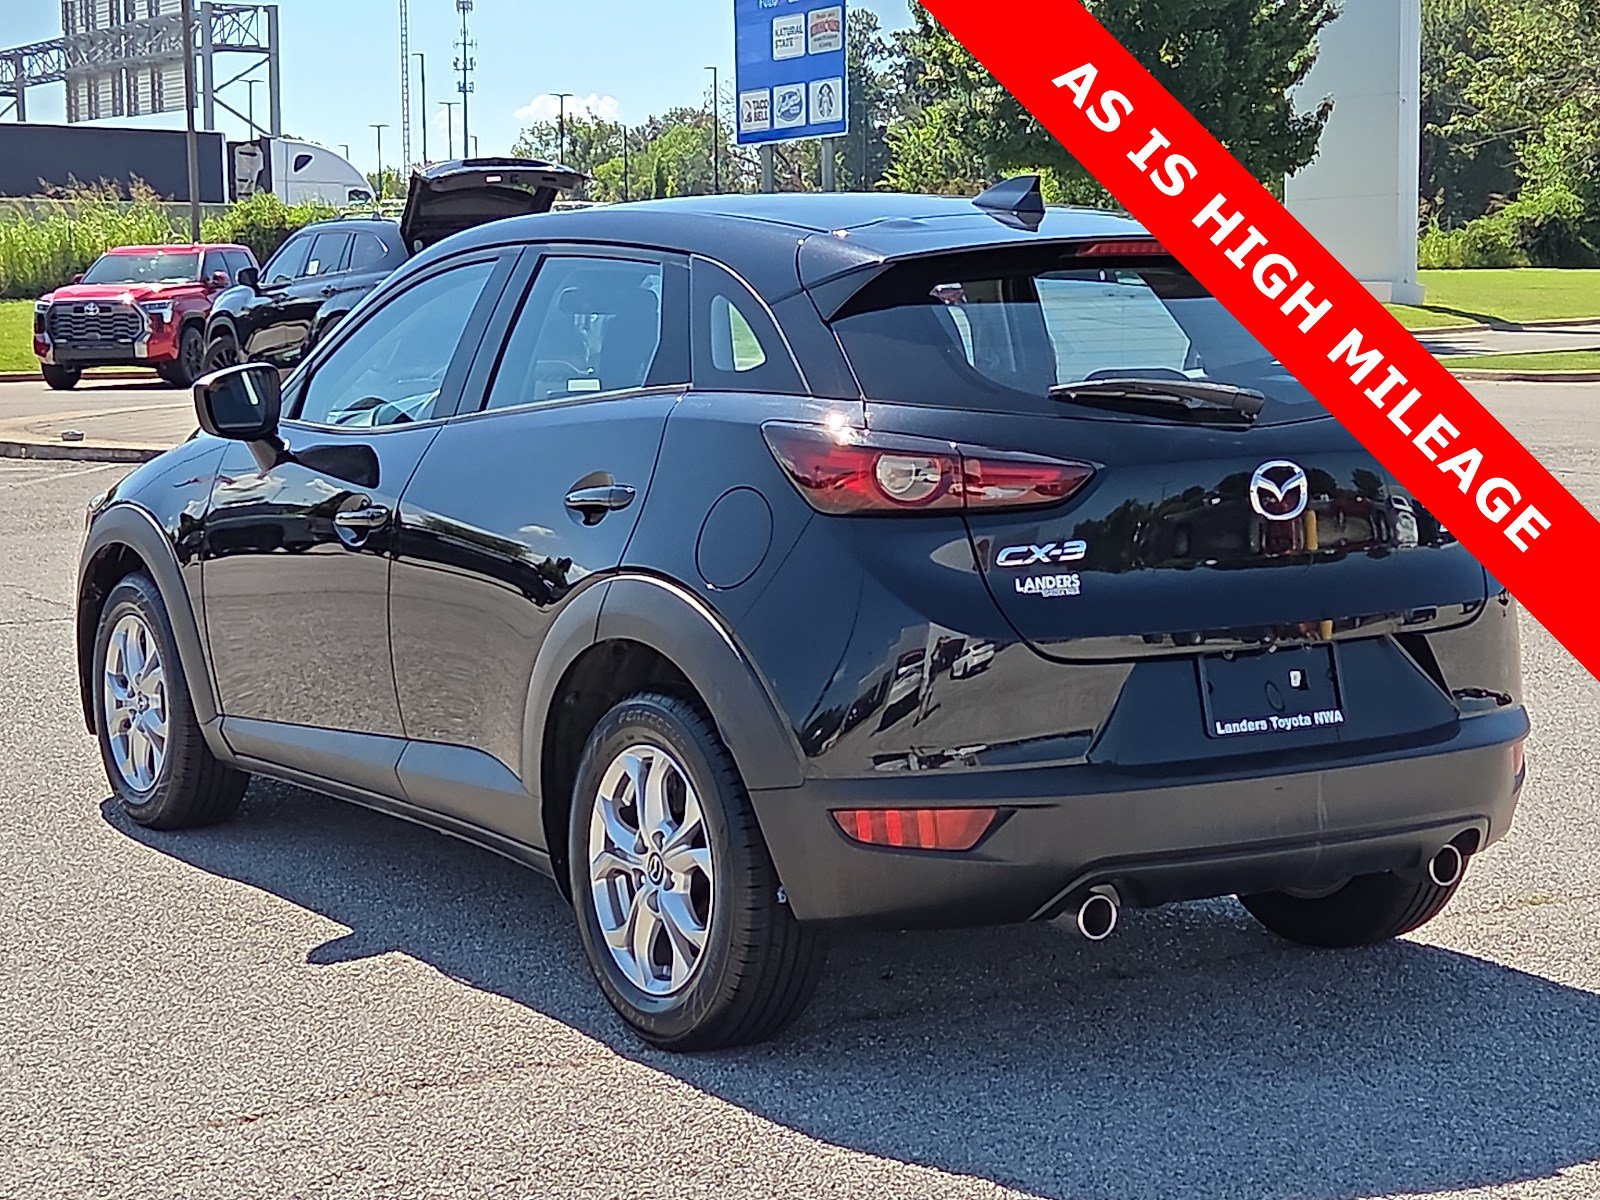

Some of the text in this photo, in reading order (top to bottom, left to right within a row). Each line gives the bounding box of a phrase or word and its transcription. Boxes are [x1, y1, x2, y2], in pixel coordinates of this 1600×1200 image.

[752, 99, 768, 109] TACO
[753, 111, 768, 121] BELL
[996, 540, 1087, 566] CX-3
[1015, 573, 1080, 593] LANDERS
[1215, 710, 1344, 735] Landers Toyota NWA
